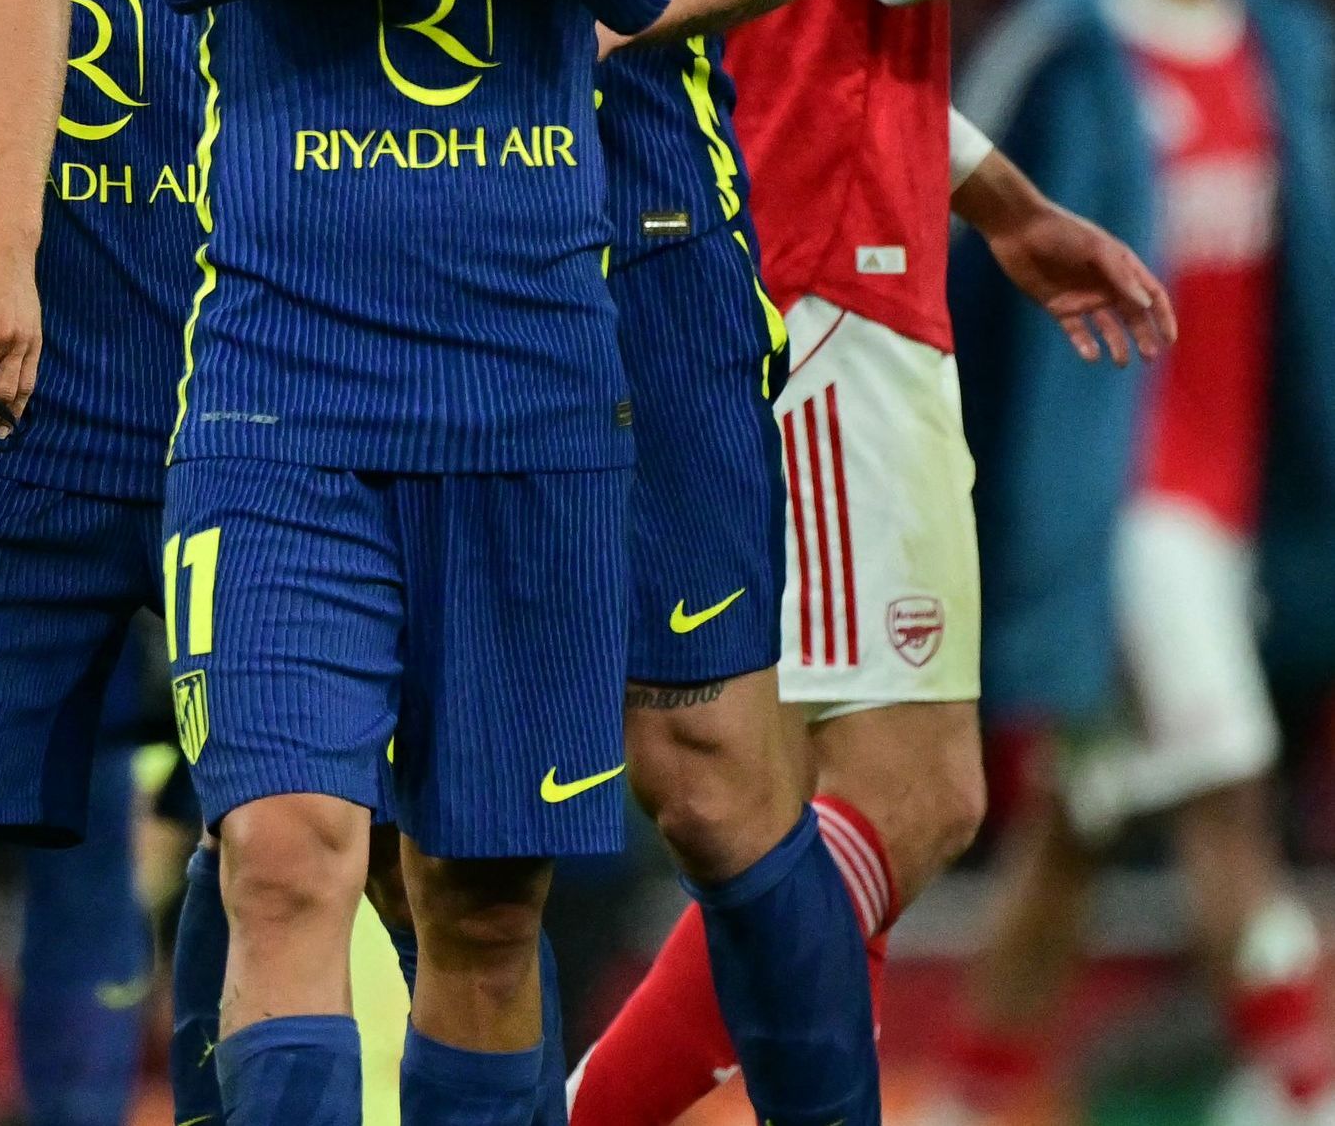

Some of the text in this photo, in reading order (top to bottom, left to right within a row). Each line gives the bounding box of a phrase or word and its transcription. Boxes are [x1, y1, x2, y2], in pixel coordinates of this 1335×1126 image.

[294, 125, 578, 171] RIYADH AIR
[45, 162, 196, 204] ADH AI
[162, 526, 222, 663] 11
